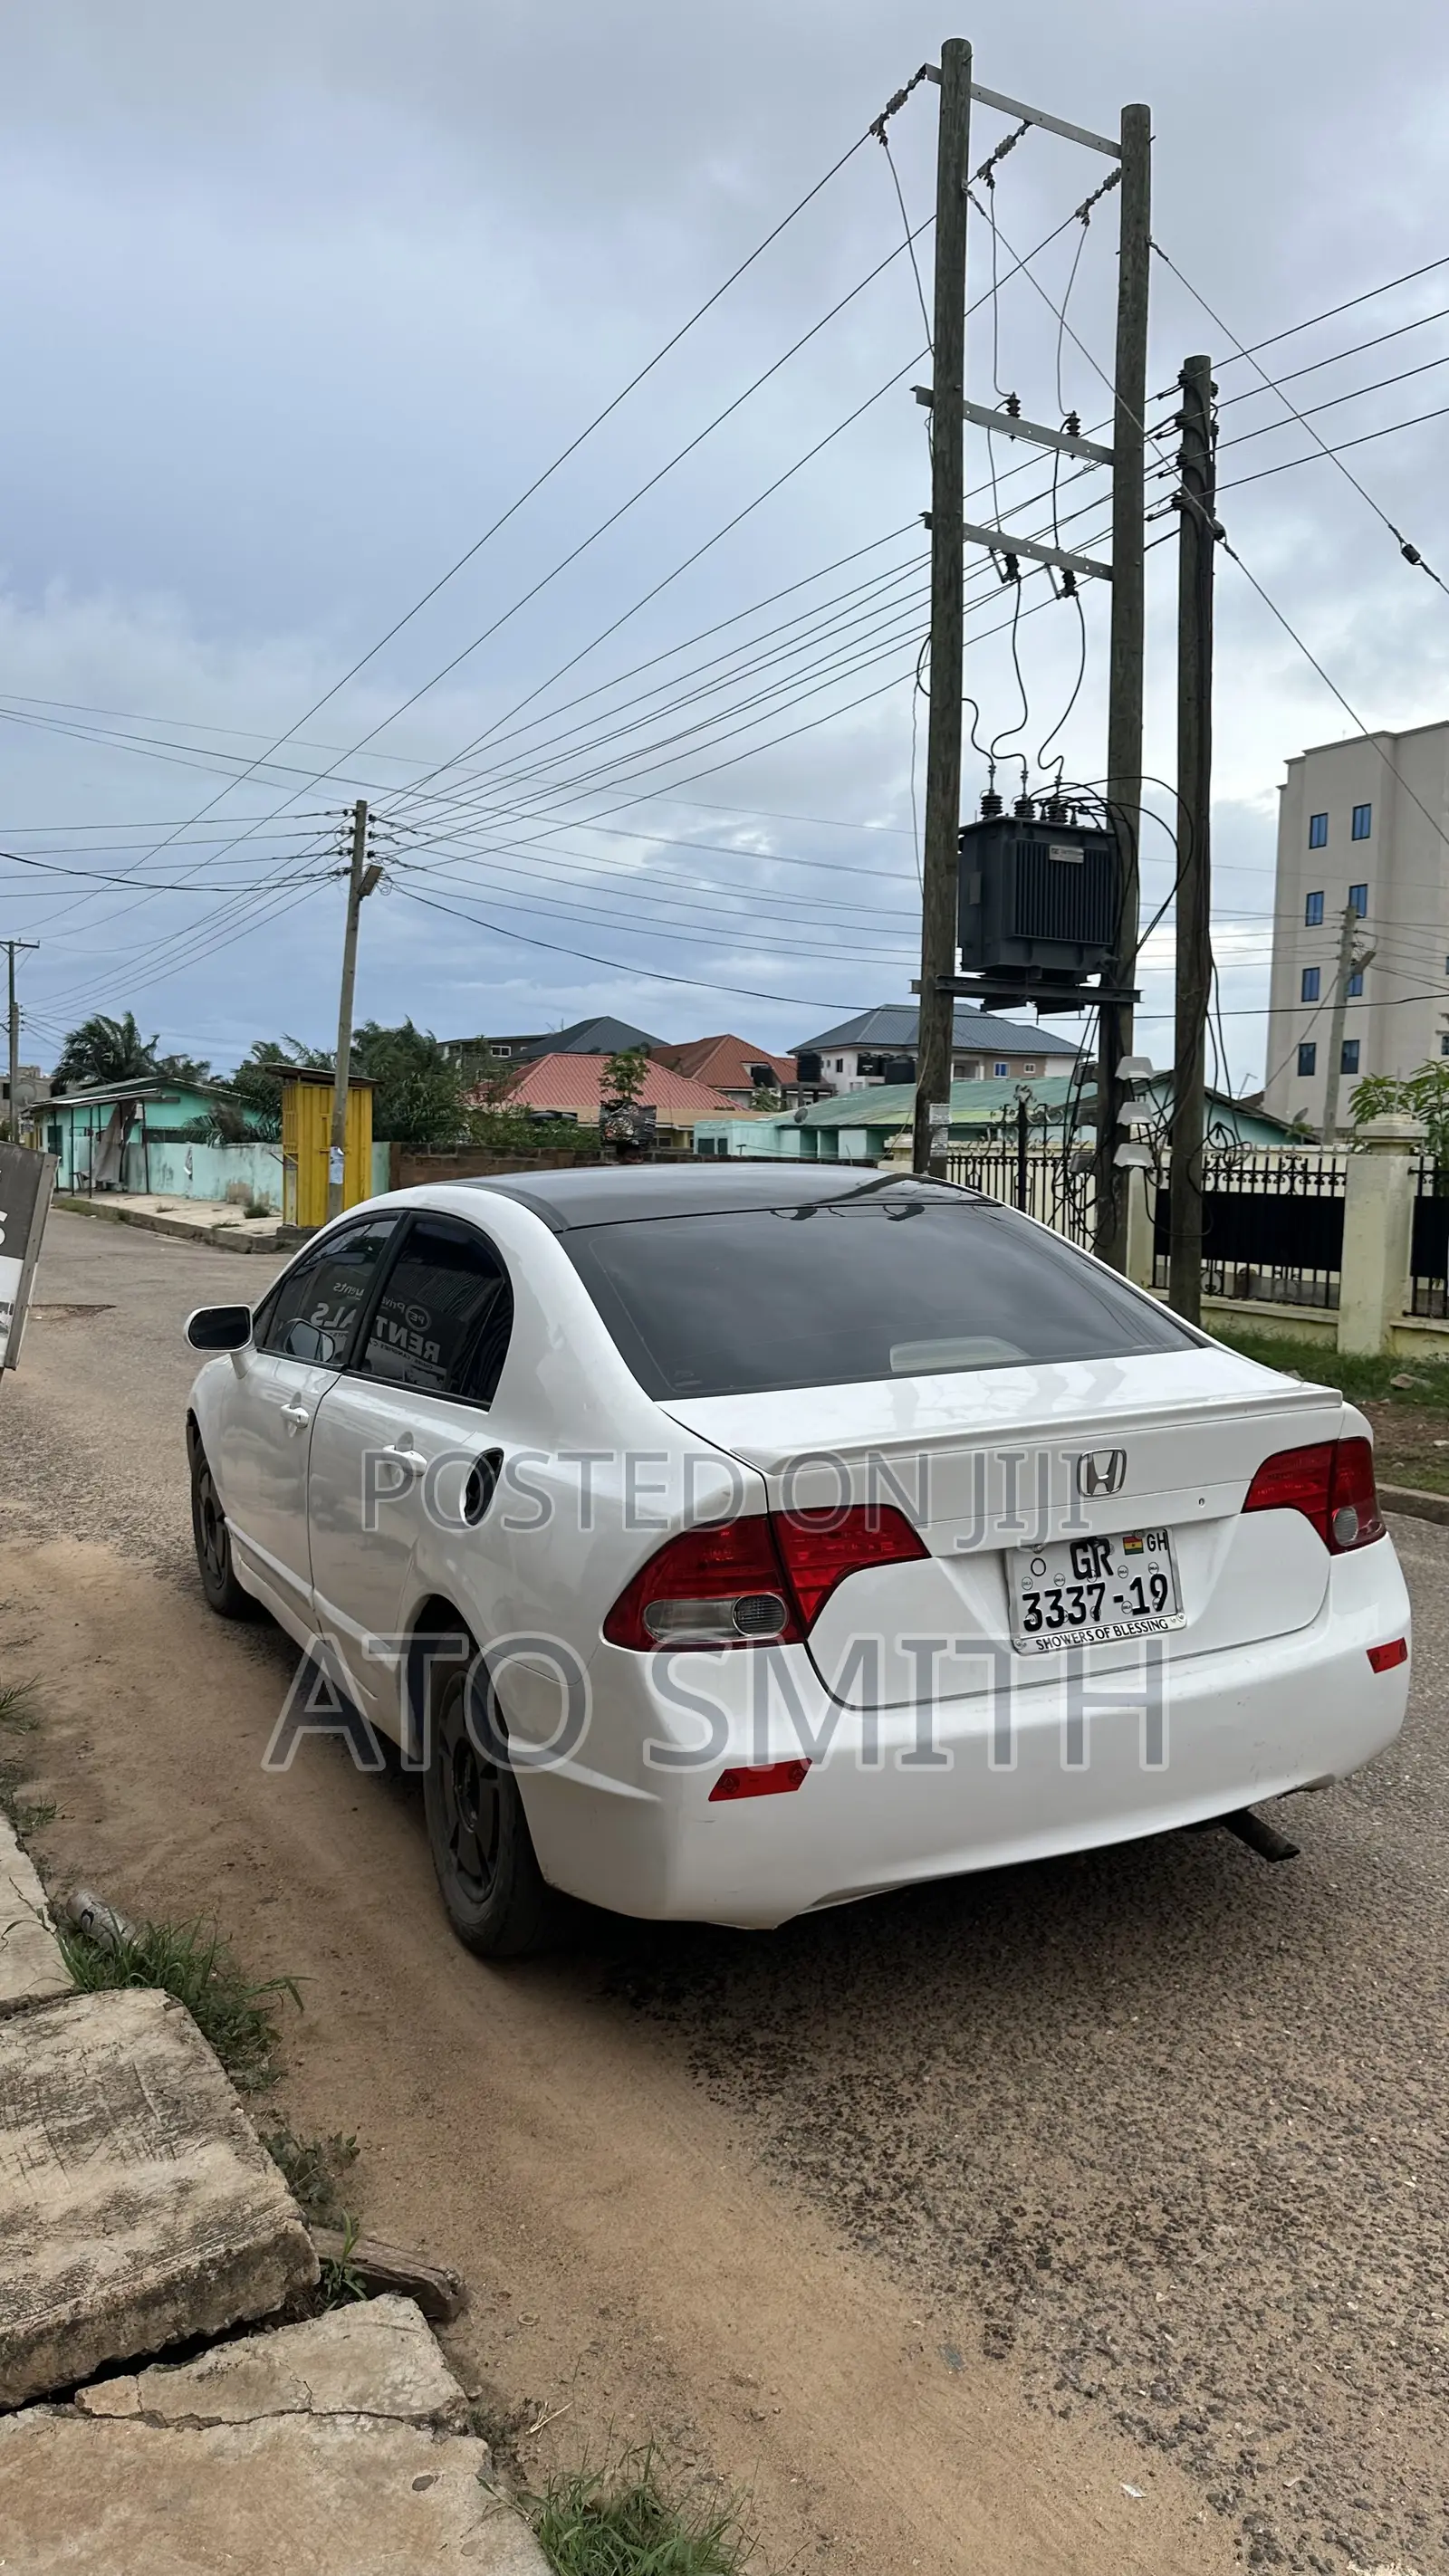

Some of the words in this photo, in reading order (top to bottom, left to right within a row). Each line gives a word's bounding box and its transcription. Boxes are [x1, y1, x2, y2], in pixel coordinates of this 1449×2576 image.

[1070, 1537, 1114, 1580] GR
[1147, 1531, 1168, 1552] GH
[1036, 1631, 1095, 1651] SHOWERS
[1095, 1627, 1111, 1641] OF
[1115, 1618, 1169, 1637] BLESSING
